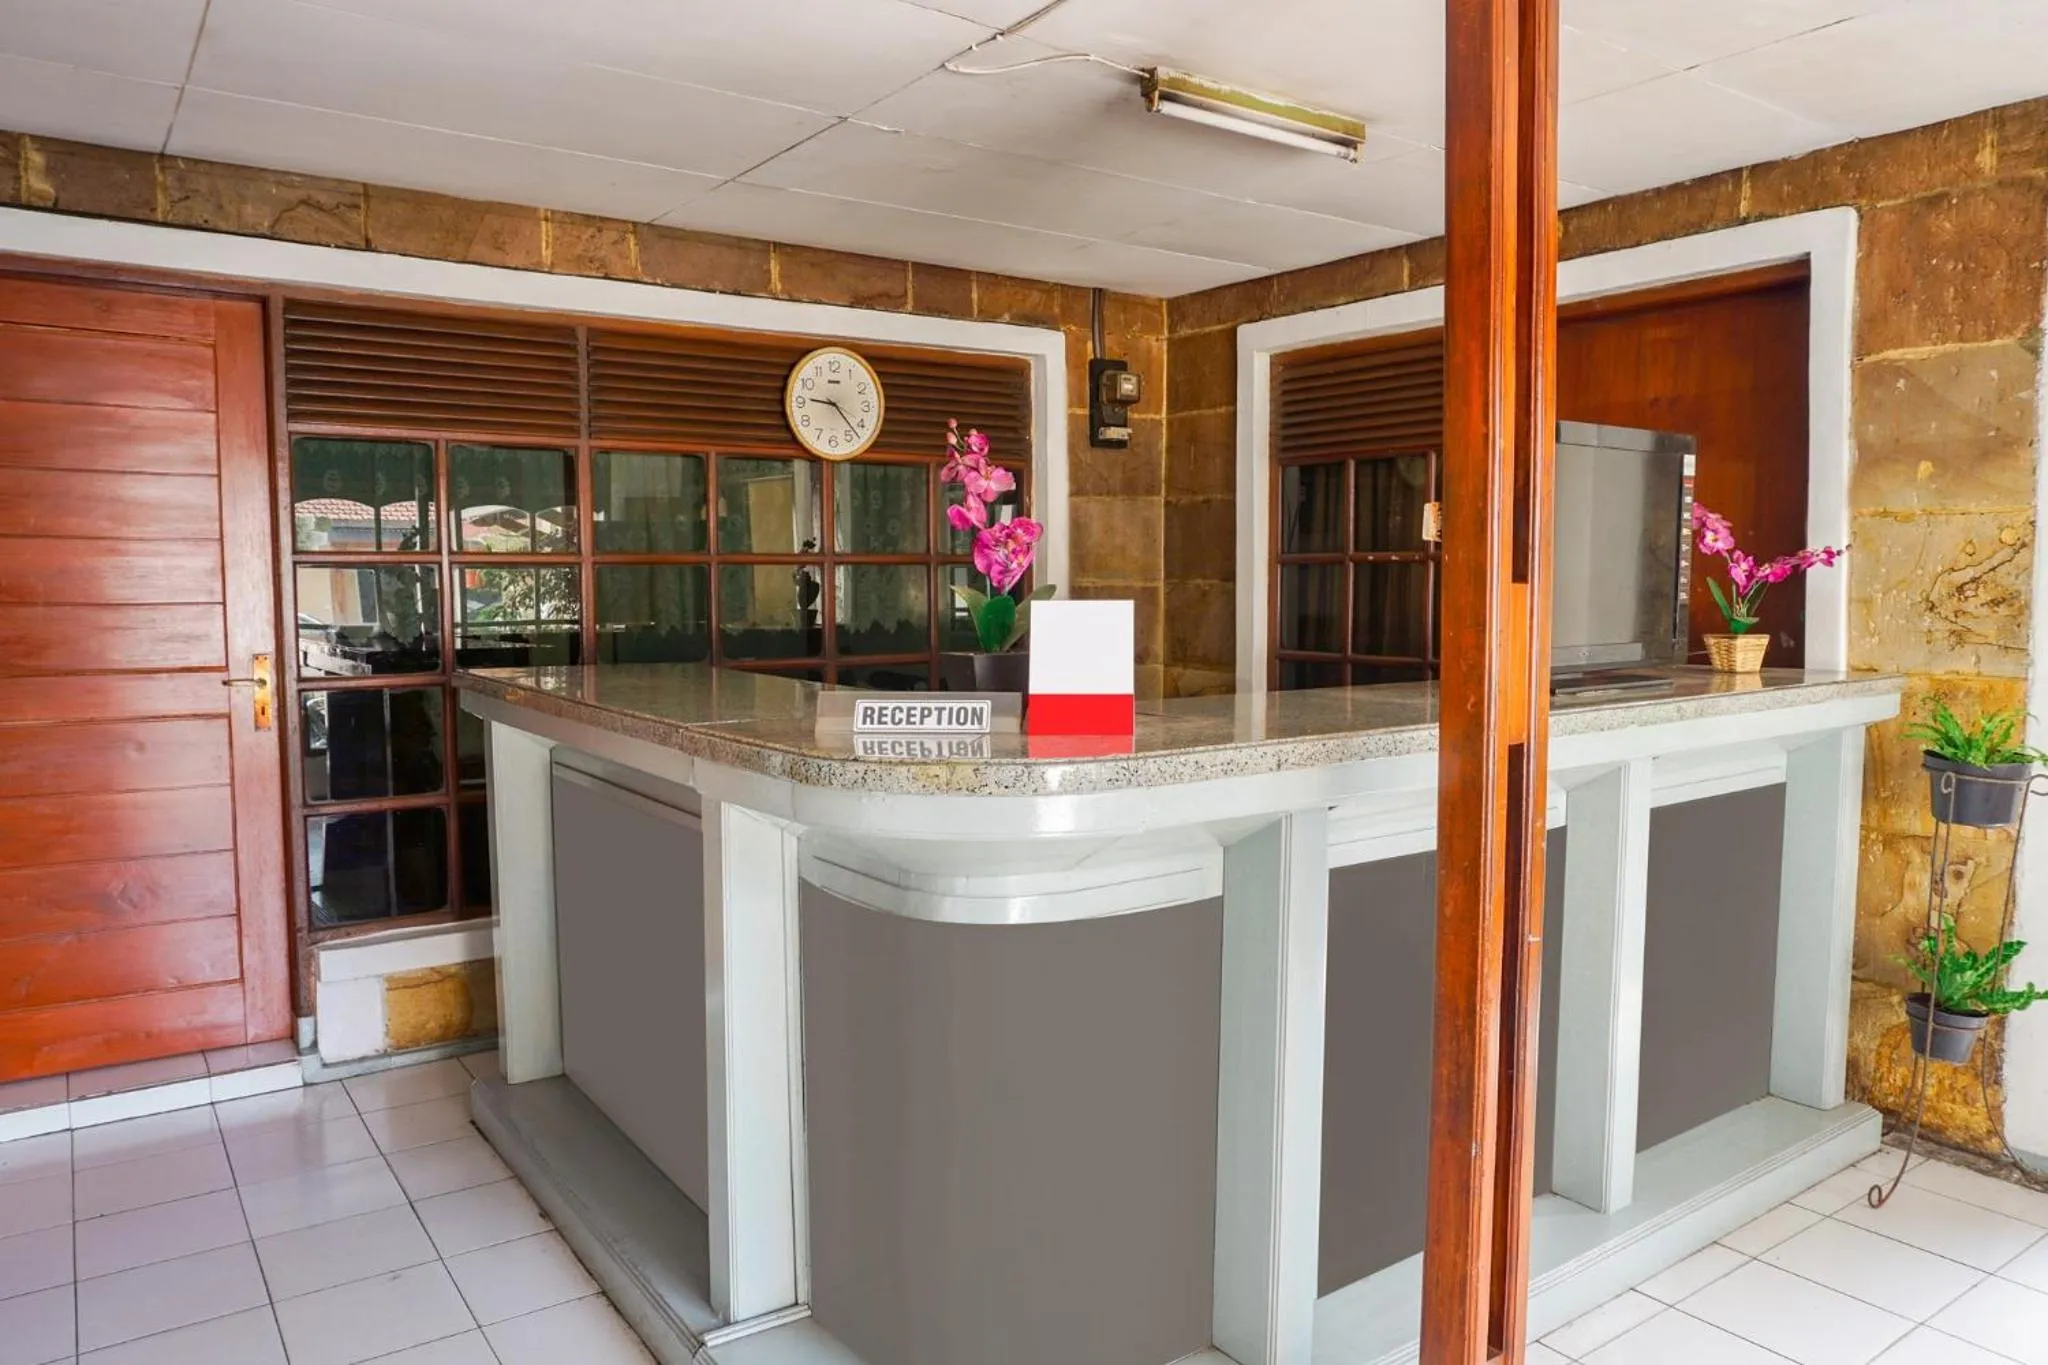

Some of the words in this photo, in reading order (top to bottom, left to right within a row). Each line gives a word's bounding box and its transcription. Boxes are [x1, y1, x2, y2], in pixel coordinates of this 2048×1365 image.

[815, 366, 823, 377] 11
[828, 360, 841, 373] 12
[848, 368, 852, 380] 1
[801, 377, 815, 391] 10
[857, 382, 867, 395] 2
[795, 395, 806, 408] 9
[861, 400, 870, 413] 3
[801, 414, 811, 427] 8
[857, 418, 866, 429] 4
[814, 428, 824, 441] 7
[844, 429, 853, 442] 5
[828, 435, 839, 448] 6
[861, 706, 984, 726] RECEPTION
